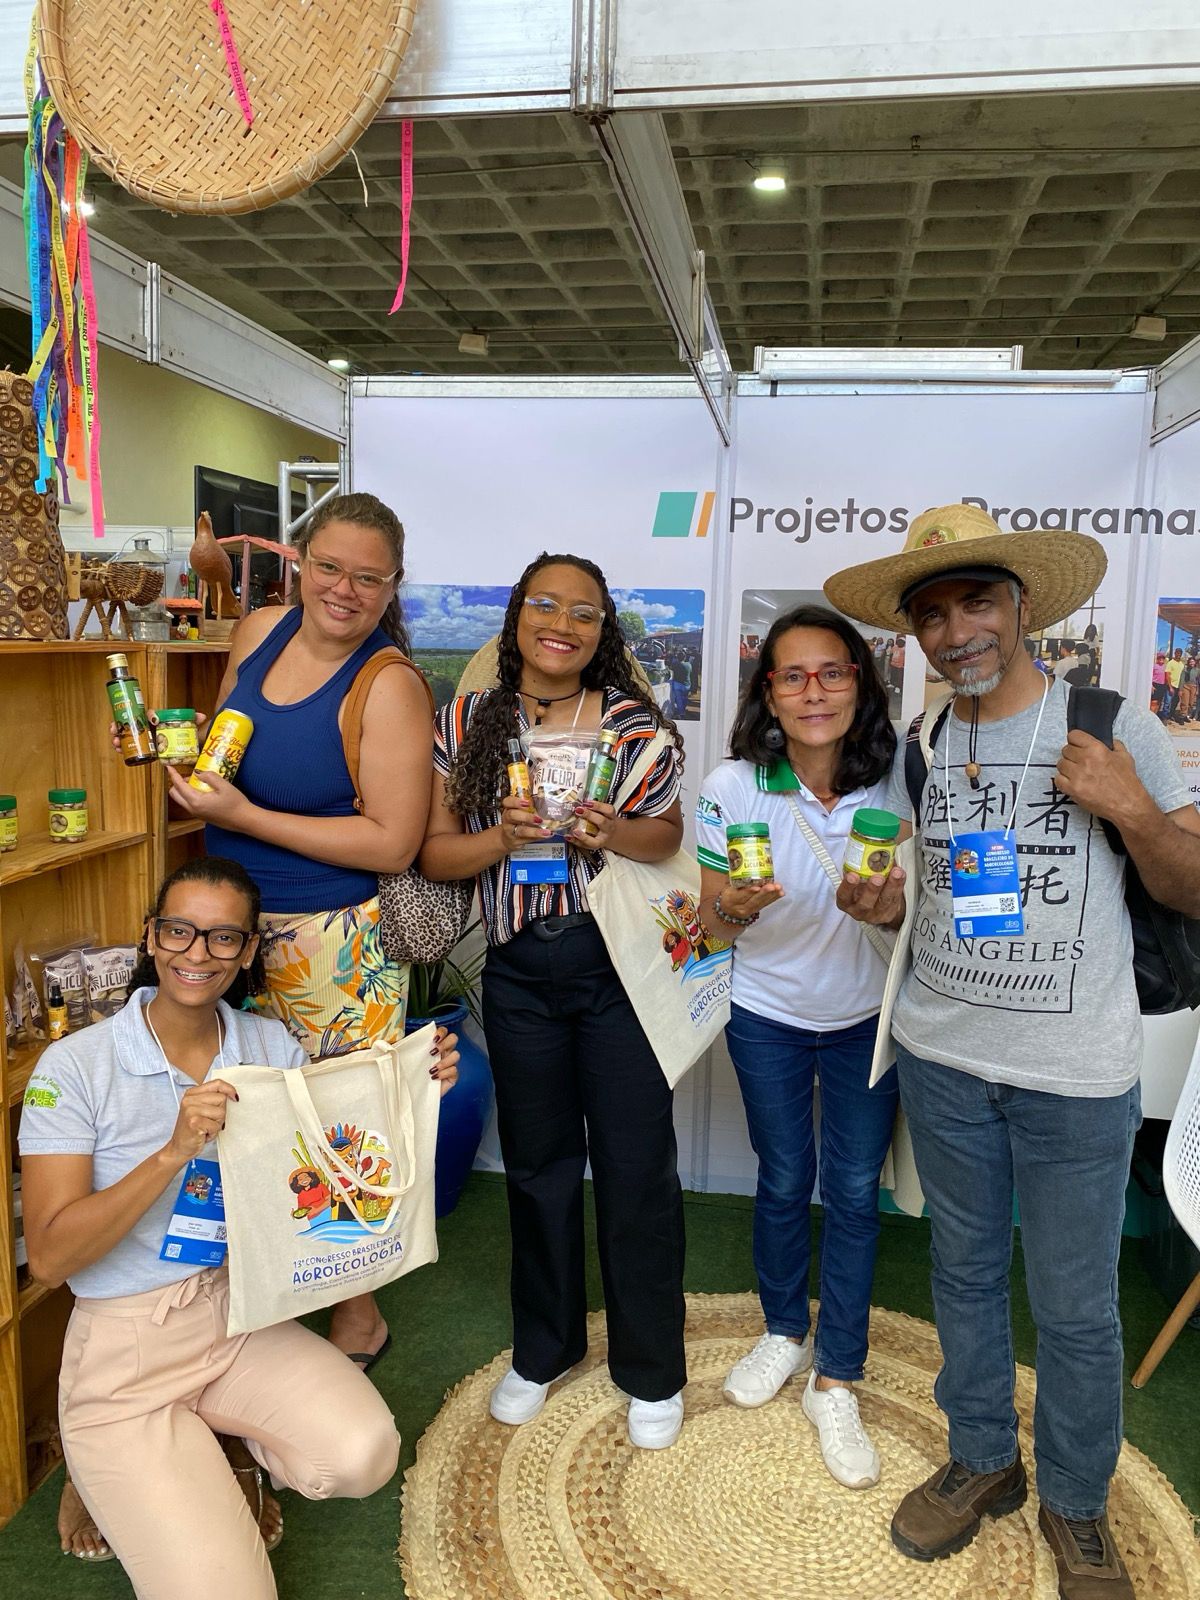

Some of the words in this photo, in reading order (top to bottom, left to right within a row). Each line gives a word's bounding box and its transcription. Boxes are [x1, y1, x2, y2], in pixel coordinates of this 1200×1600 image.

[730, 496, 909, 544] Projetos
[914, 911, 937, 943] LOS
[940, 930, 1085, 962] ANGELES
[100, 969, 132, 988] LICURI
[293, 1241, 402, 1285] AGROECOLOGIA
[306, 1250, 350, 1266] CONGRESSO
[352, 1237, 393, 1256] BRASILEIRO
